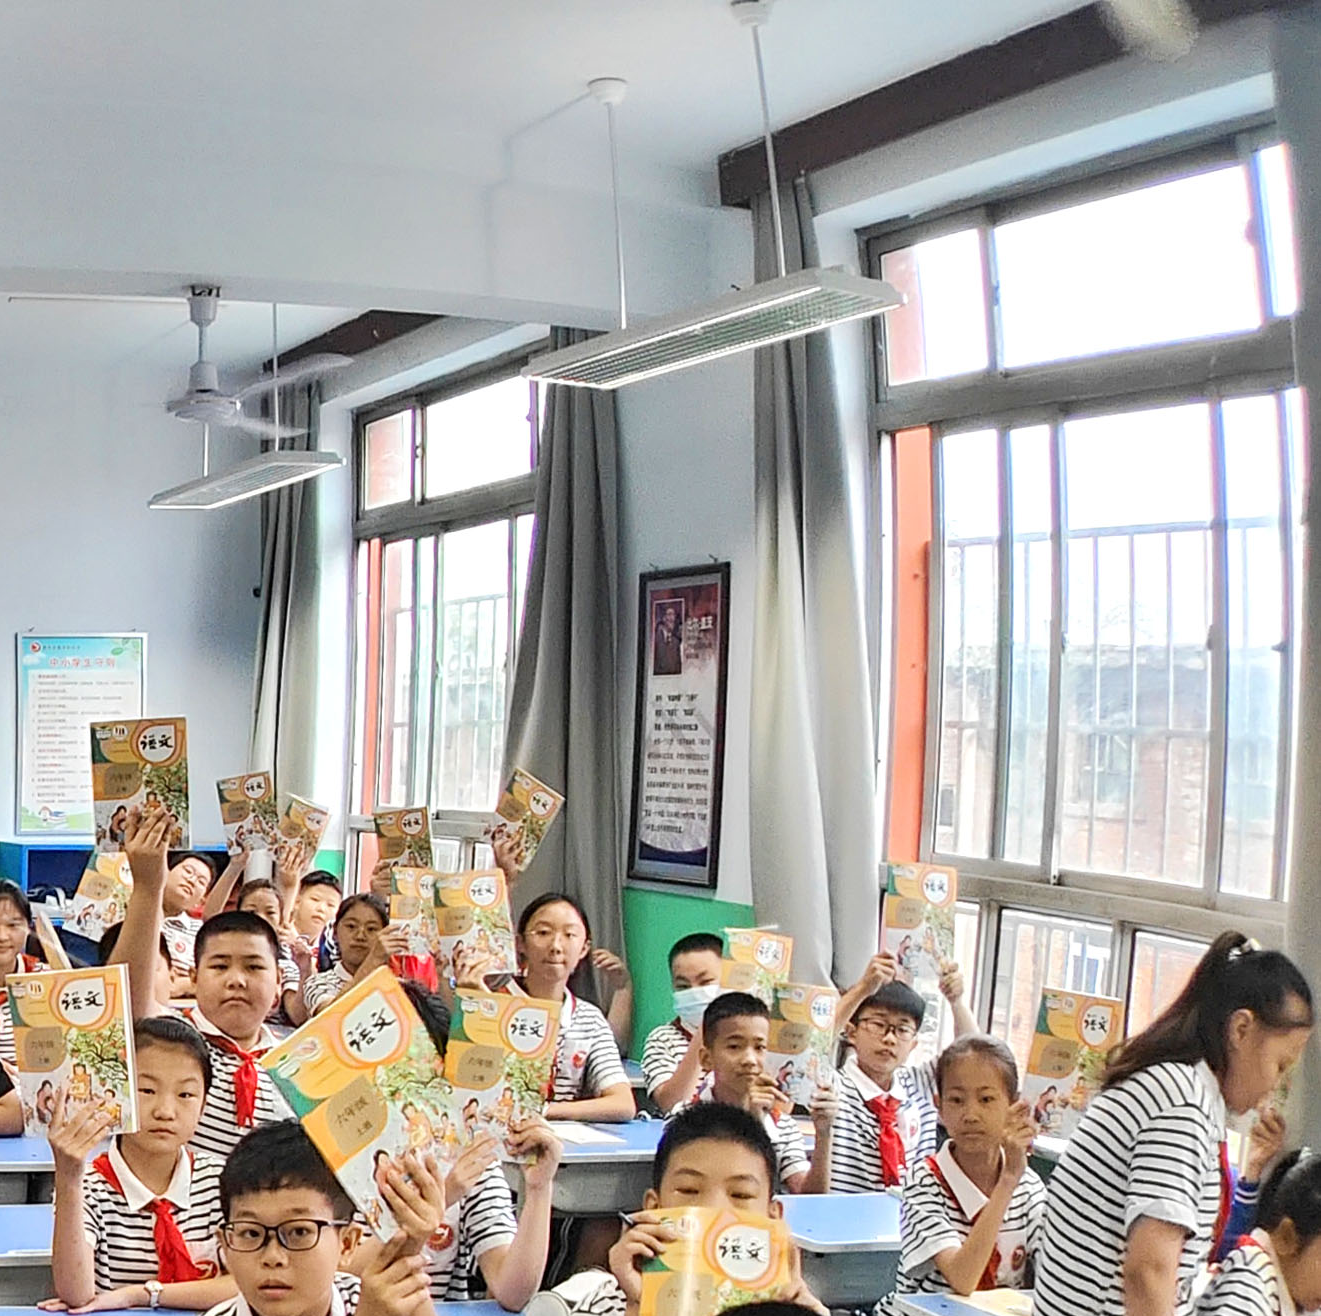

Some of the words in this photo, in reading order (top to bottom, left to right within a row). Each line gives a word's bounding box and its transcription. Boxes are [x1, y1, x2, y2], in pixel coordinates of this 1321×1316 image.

[140, 736, 174, 752] 语文
[62, 989, 104, 1009] 语文
[347, 1007, 394, 1051] 语文
[511, 1018, 544, 1039] 语文
[1085, 1013, 1108, 1034] 语文
[719, 1236, 765, 1261] 语文
